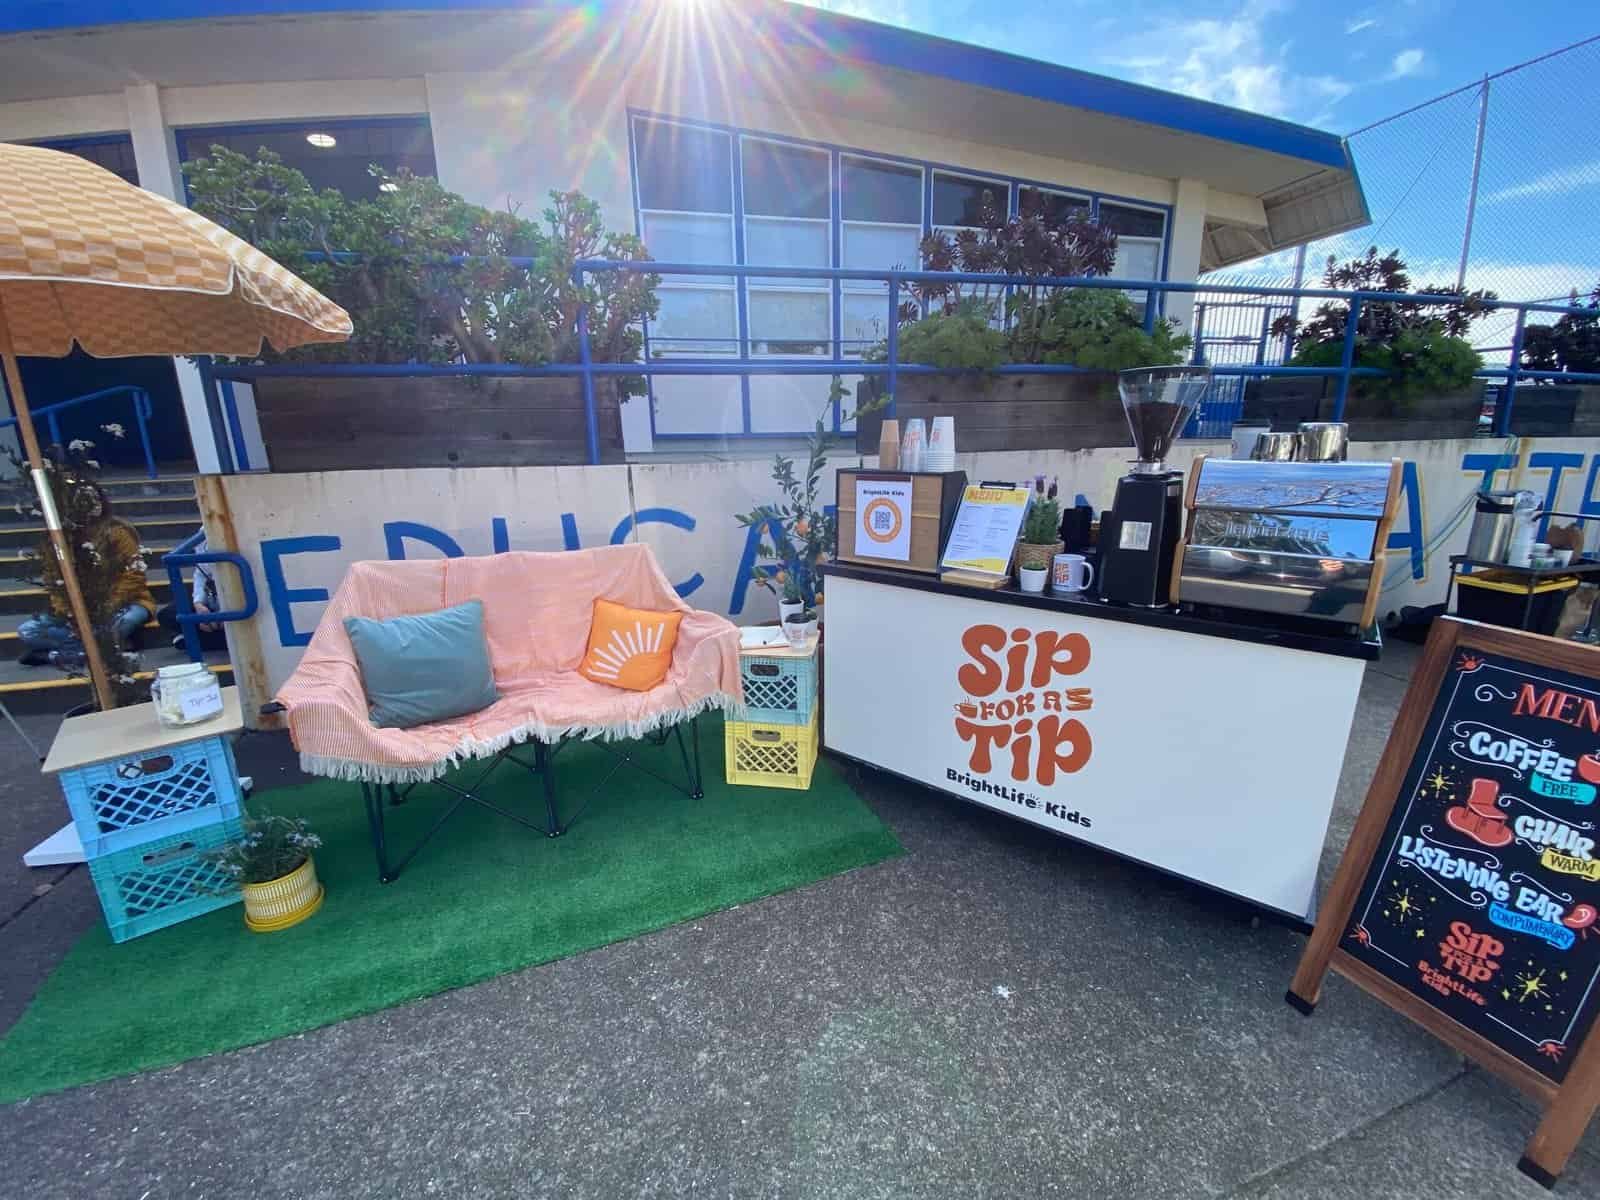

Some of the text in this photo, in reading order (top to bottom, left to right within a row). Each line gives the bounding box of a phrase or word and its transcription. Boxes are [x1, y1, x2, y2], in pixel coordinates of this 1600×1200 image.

[979, 691, 1036, 721] FOR
[1469, 731, 1577, 782] COFFEE
[946, 767, 1092, 828] BrightLife Kids
[1542, 781, 1579, 797] FREE
[1514, 815, 1596, 862] CHAIR
[1398, 835, 1565, 925] LISTENING EAR
[1549, 854, 1596, 875] WARM
